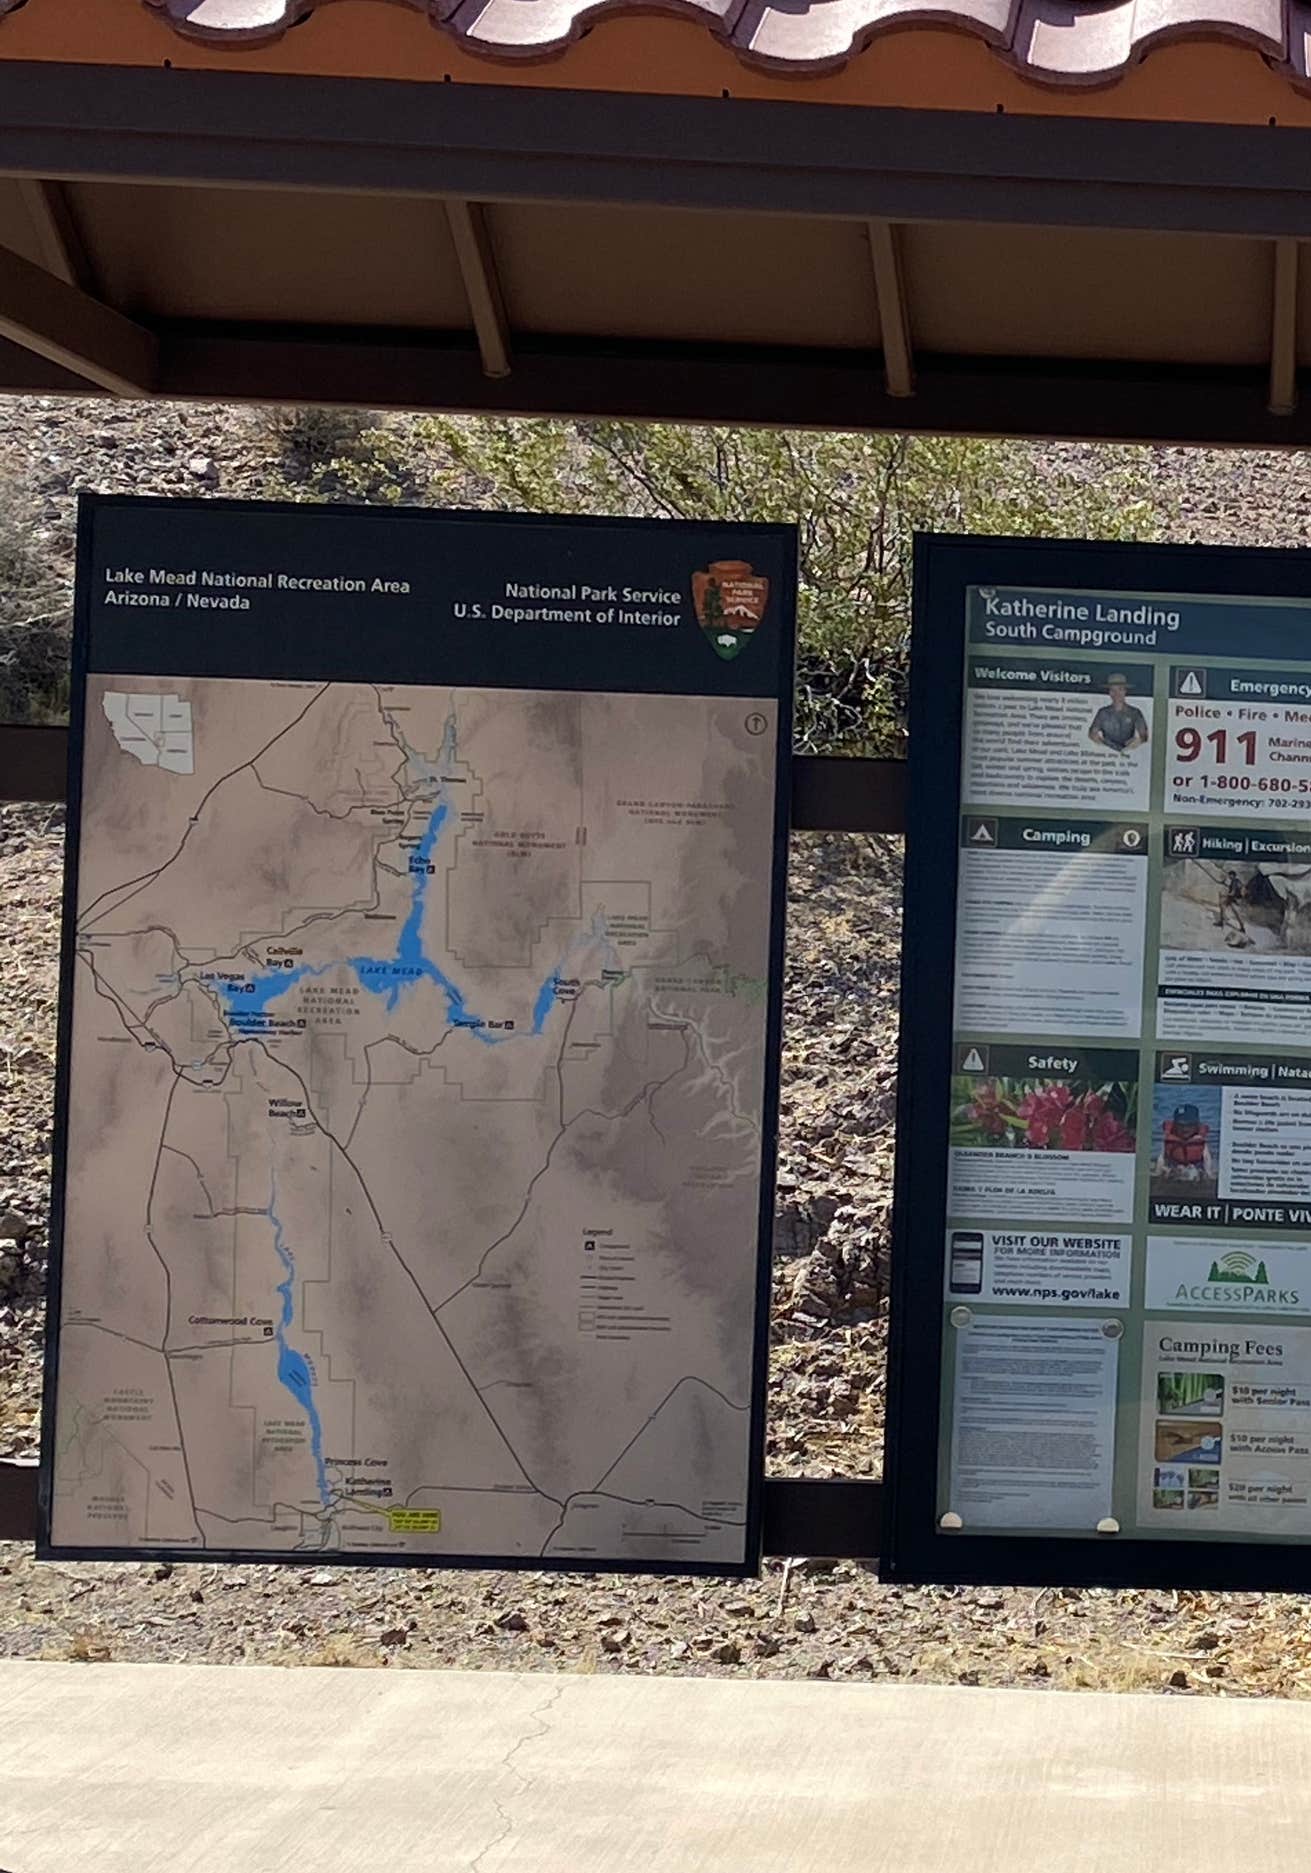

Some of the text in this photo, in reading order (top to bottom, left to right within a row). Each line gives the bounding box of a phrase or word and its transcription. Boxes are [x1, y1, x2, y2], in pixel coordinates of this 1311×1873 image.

[106, 568, 409, 592] Lake Mead National Recreation Area
[105, 591, 249, 609] Arizona / Nevada
[506, 584, 680, 603] National Park Service
[455, 604, 680, 625] U.S. Department of Interior
[986, 598, 1180, 631] Katherine Landing
[985, 621, 1157, 646] South Campground
[975, 667, 1091, 684] Welcome Visitors
[1175, 706, 1221, 719] Police
[1238, 708, 1267, 720] Fire
[1175, 728, 1257, 765] 911
[1268, 737, 1311, 748] Marine
[1173, 776, 1193, 787] or
[1173, 794, 1264, 808] Non-Emergency:
[1022, 829, 1090, 845] Camping
[1202, 838, 1242, 853] Hiking
[200, 972, 245, 981] Las Vegas
[361, 966, 423, 976] LAKE MEAD
[229, 1018, 295, 1028] Boulder Beach
[1028, 1056, 1077, 1073] Safety
[1199, 1063, 1268, 1080] Swimming
[1155, 1204, 1202, 1217] WEAR
[1207, 1206, 1221, 1219] IT
[1233, 1208, 1284, 1221] PONTE
[992, 1236, 1121, 1249] VISIT OUR WEBSITE
[992, 1287, 1120, 1300] www.nps.gov/lake
[188, 1316, 272, 1326] Cottonwood Cove
[1159, 1337, 1283, 1357] Camping Fees
